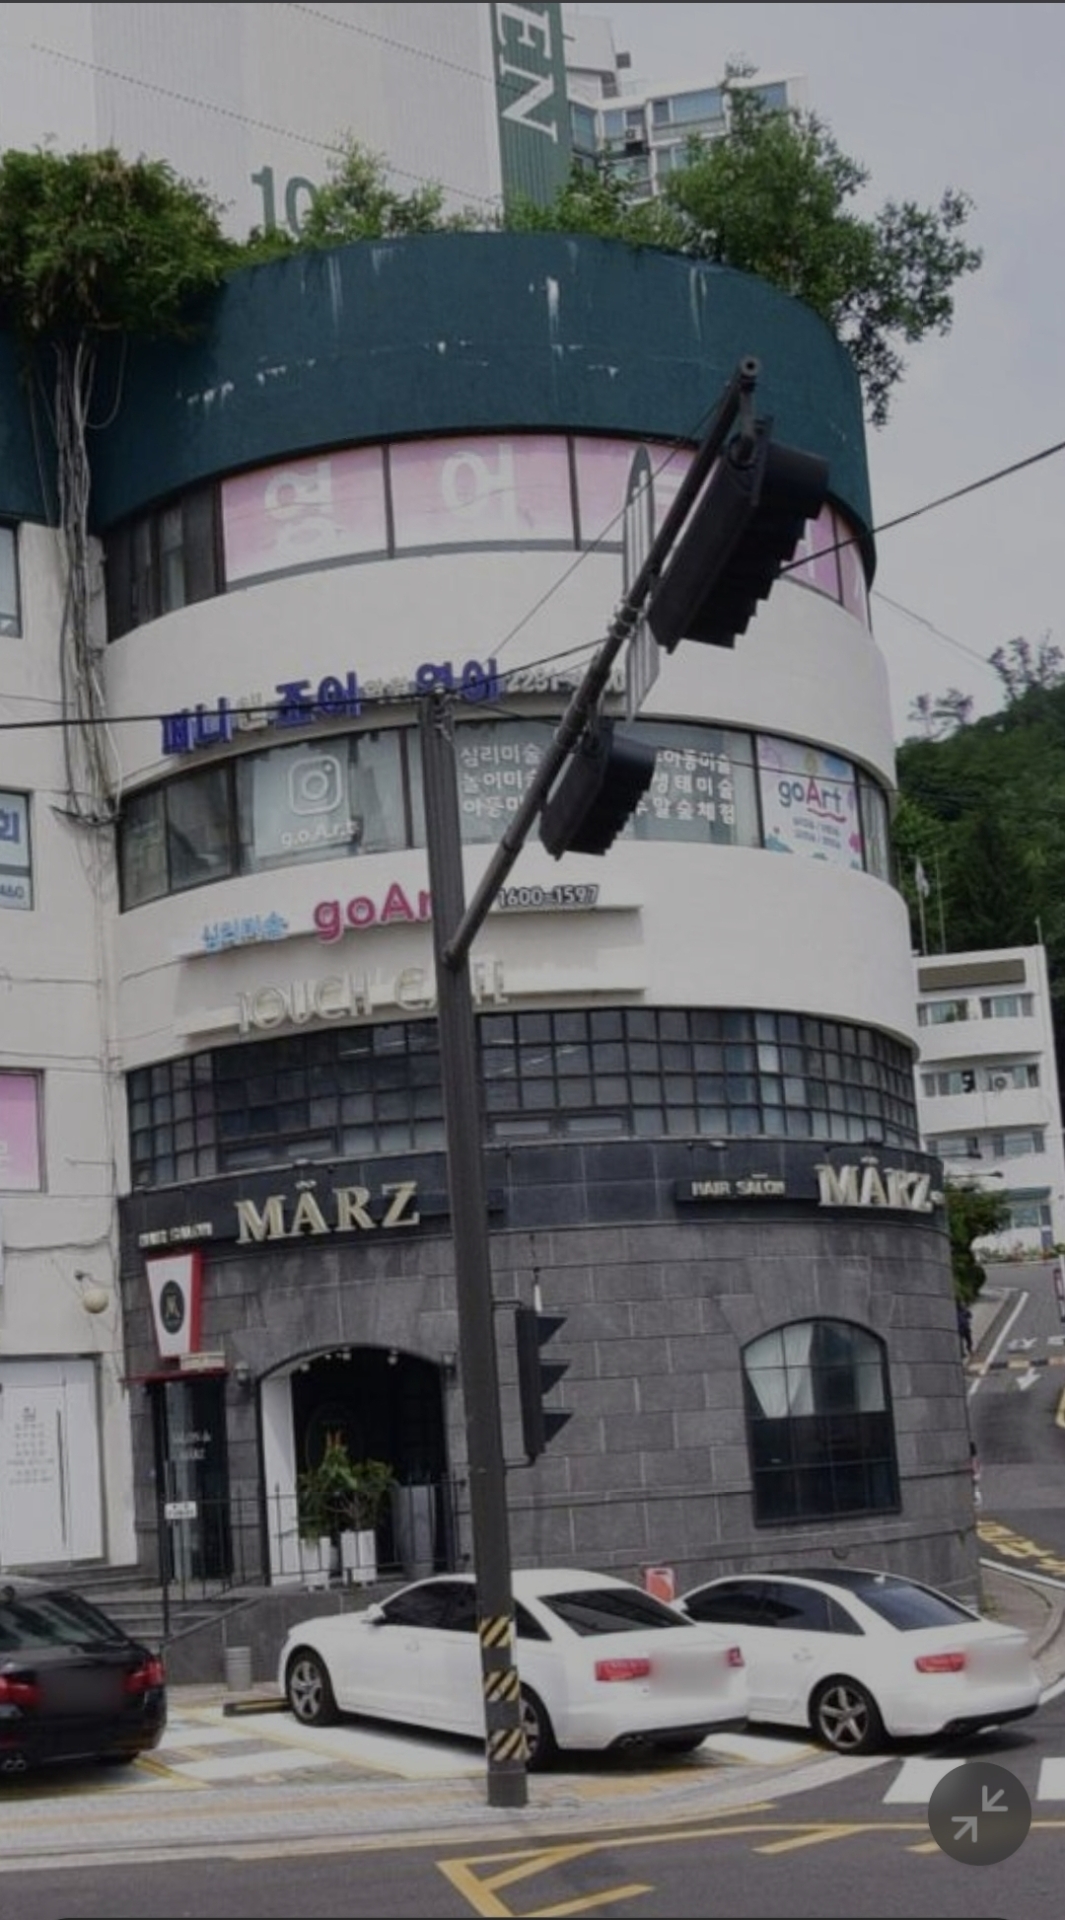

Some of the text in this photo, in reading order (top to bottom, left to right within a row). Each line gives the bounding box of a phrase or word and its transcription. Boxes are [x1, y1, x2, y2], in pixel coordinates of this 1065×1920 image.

[656, 748, 731, 774] 아동미술
[777, 776, 842, 813] goArt
[313, 881, 431, 943] goAr
[498, 884, 600, 909] 1600-1597
[234, 1178, 420, 1244] MÄRZ
